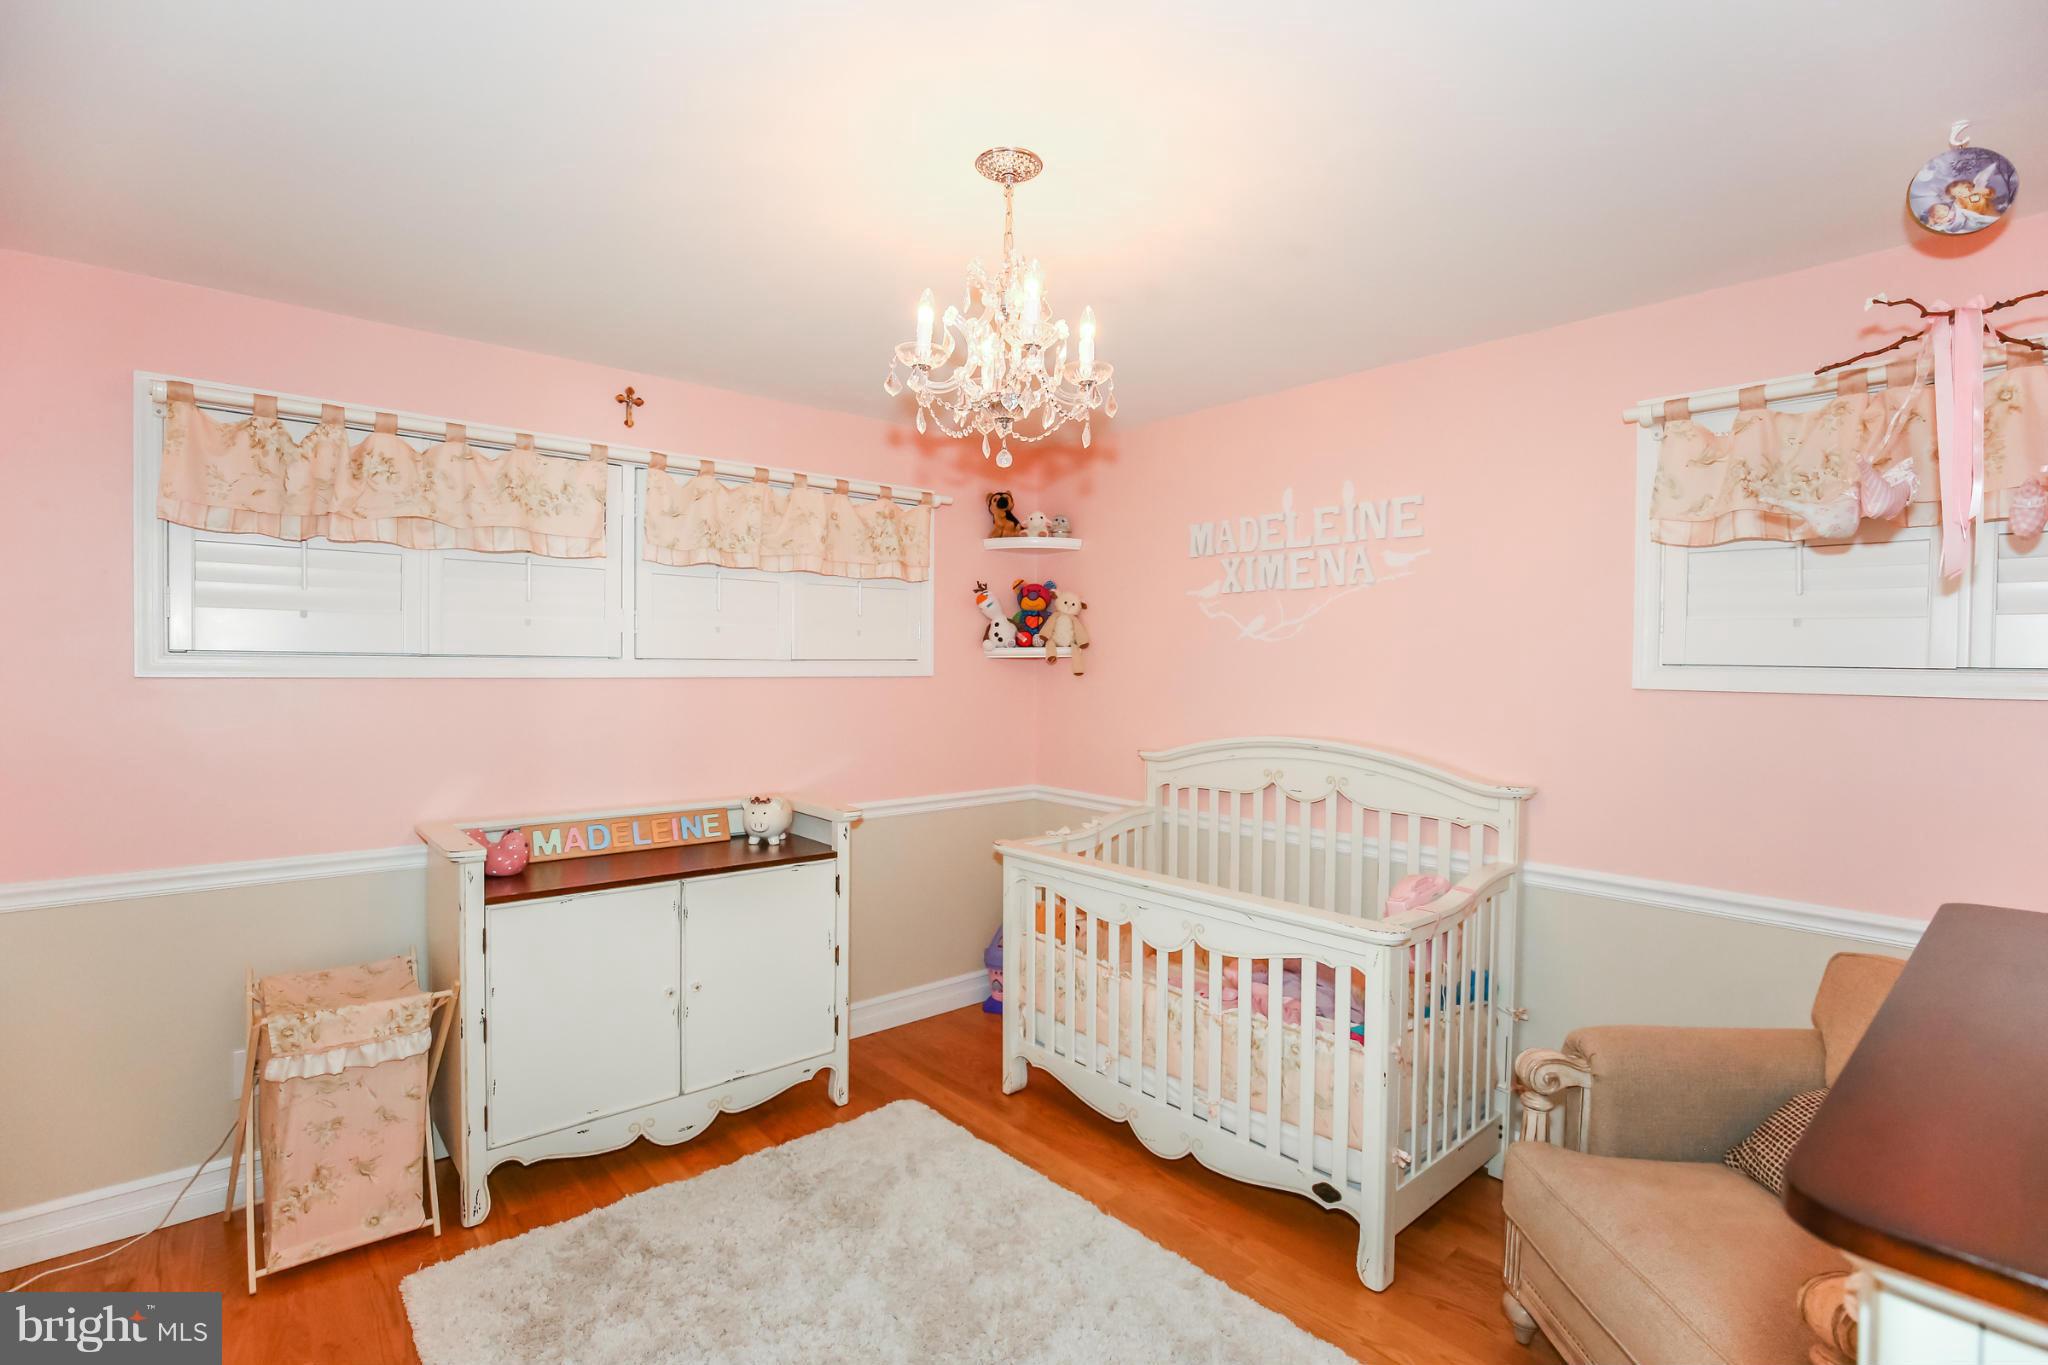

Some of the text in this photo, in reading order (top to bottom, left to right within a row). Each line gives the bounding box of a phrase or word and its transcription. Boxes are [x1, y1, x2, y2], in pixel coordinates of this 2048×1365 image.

[1189, 495, 1425, 558] MADELEINE
[1220, 547, 1376, 594] XIMENA
[531, 813, 723, 857] MADELEINE
